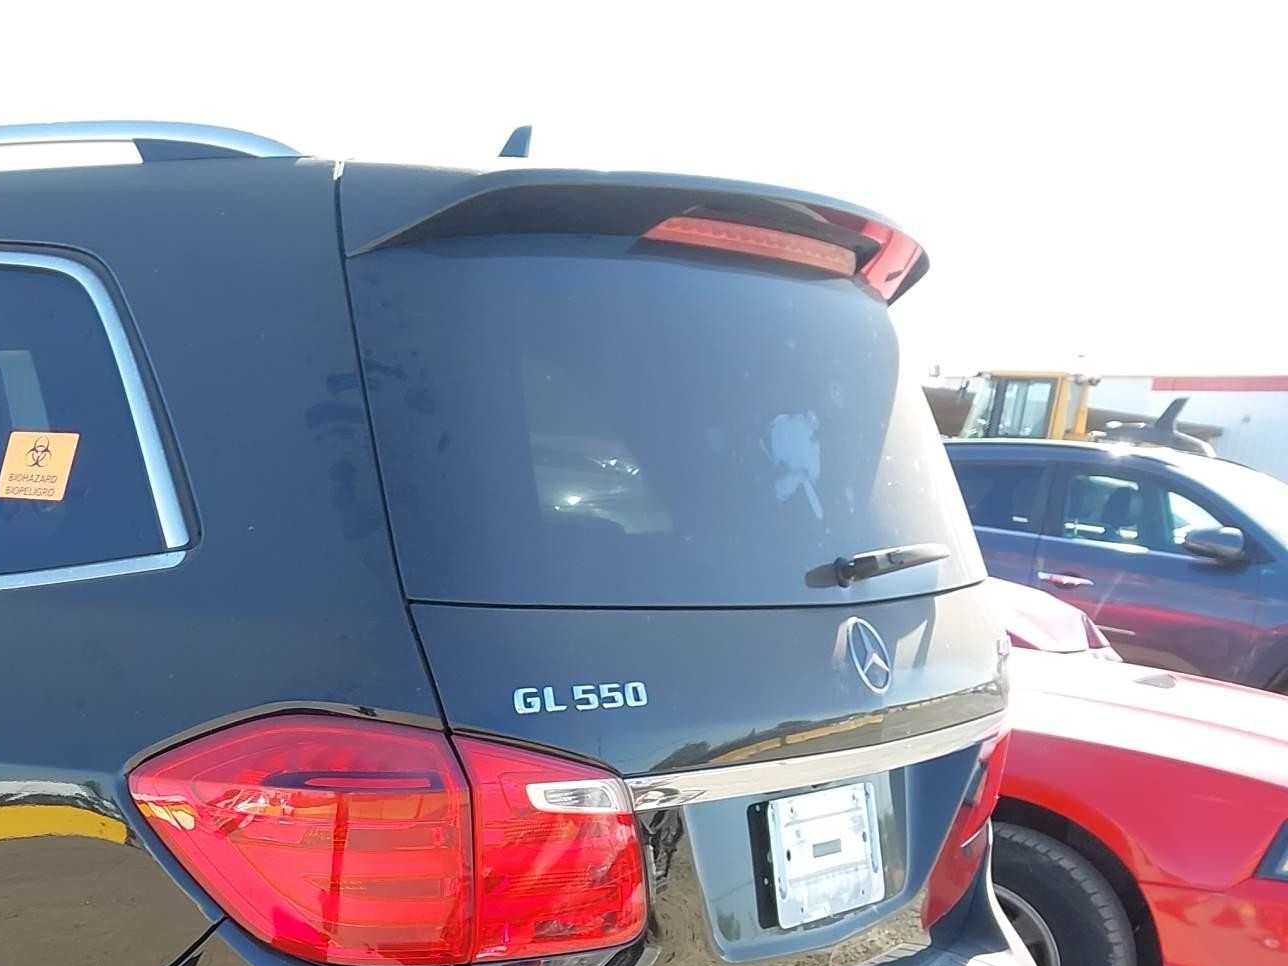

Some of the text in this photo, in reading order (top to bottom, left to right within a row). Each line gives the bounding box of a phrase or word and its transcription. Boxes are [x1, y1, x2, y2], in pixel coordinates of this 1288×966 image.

[7, 473, 58, 484] BIOHAZARD
[5, 485, 55, 497] BIOPELIGRO
[513, 682, 649, 714] GL 550
